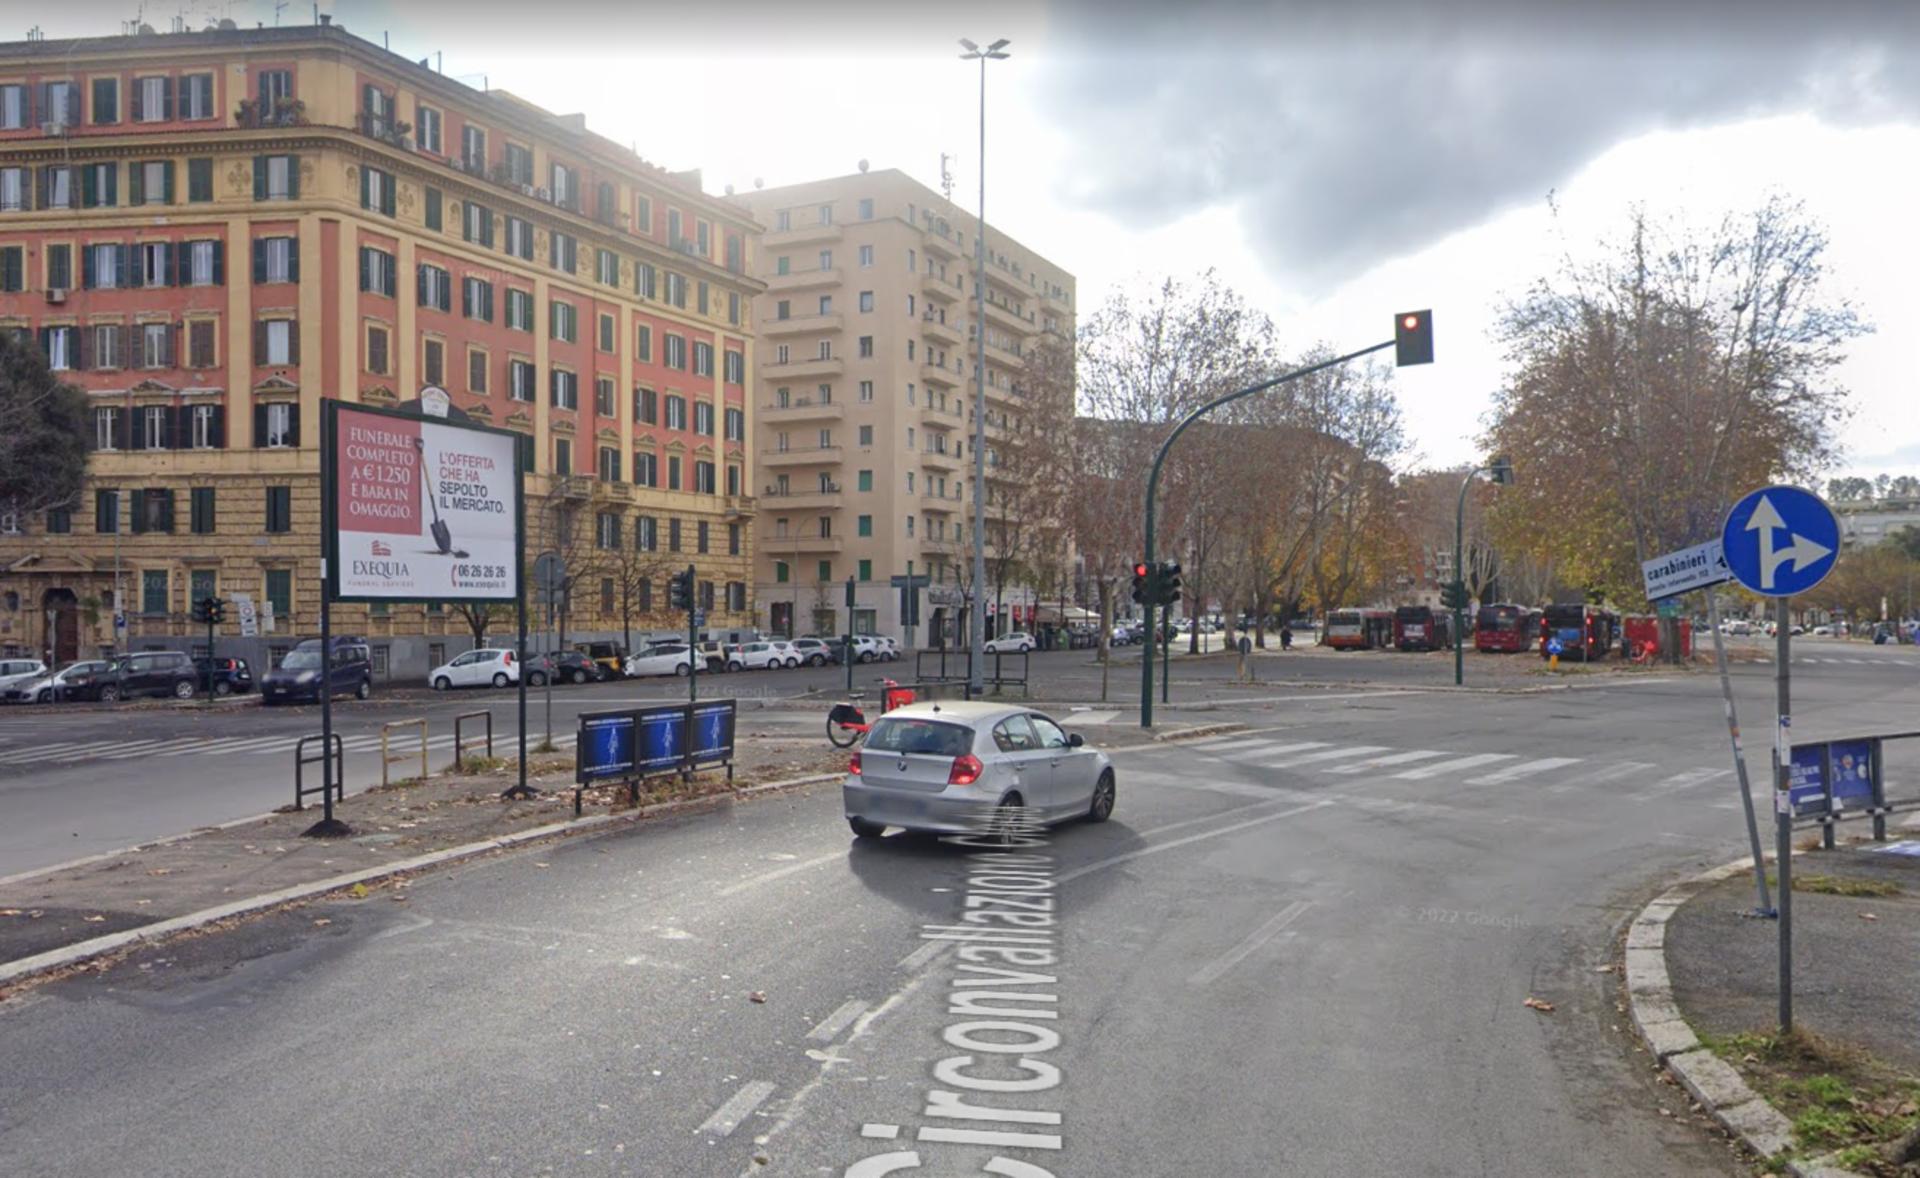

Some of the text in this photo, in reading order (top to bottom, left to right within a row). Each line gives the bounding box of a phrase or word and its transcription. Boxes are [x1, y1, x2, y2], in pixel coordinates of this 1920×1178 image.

[351, 427, 412, 448] FUNERALE
[346, 445, 414, 465] COMPLETO
[440, 452, 495, 470] L'OFFERTA
[351, 465, 360, 479] A
[440, 467, 480, 483] CHE HA
[351, 483, 409, 501] E BARA IN
[440, 481, 488, 498] SEPOLTO
[440, 496, 506, 513] IL MERCATO.
[353, 560, 410, 579] EXEQUIA
[459, 564, 506, 578] 06 26 26 26
[1647, 550, 1707, 580] carabinieri
